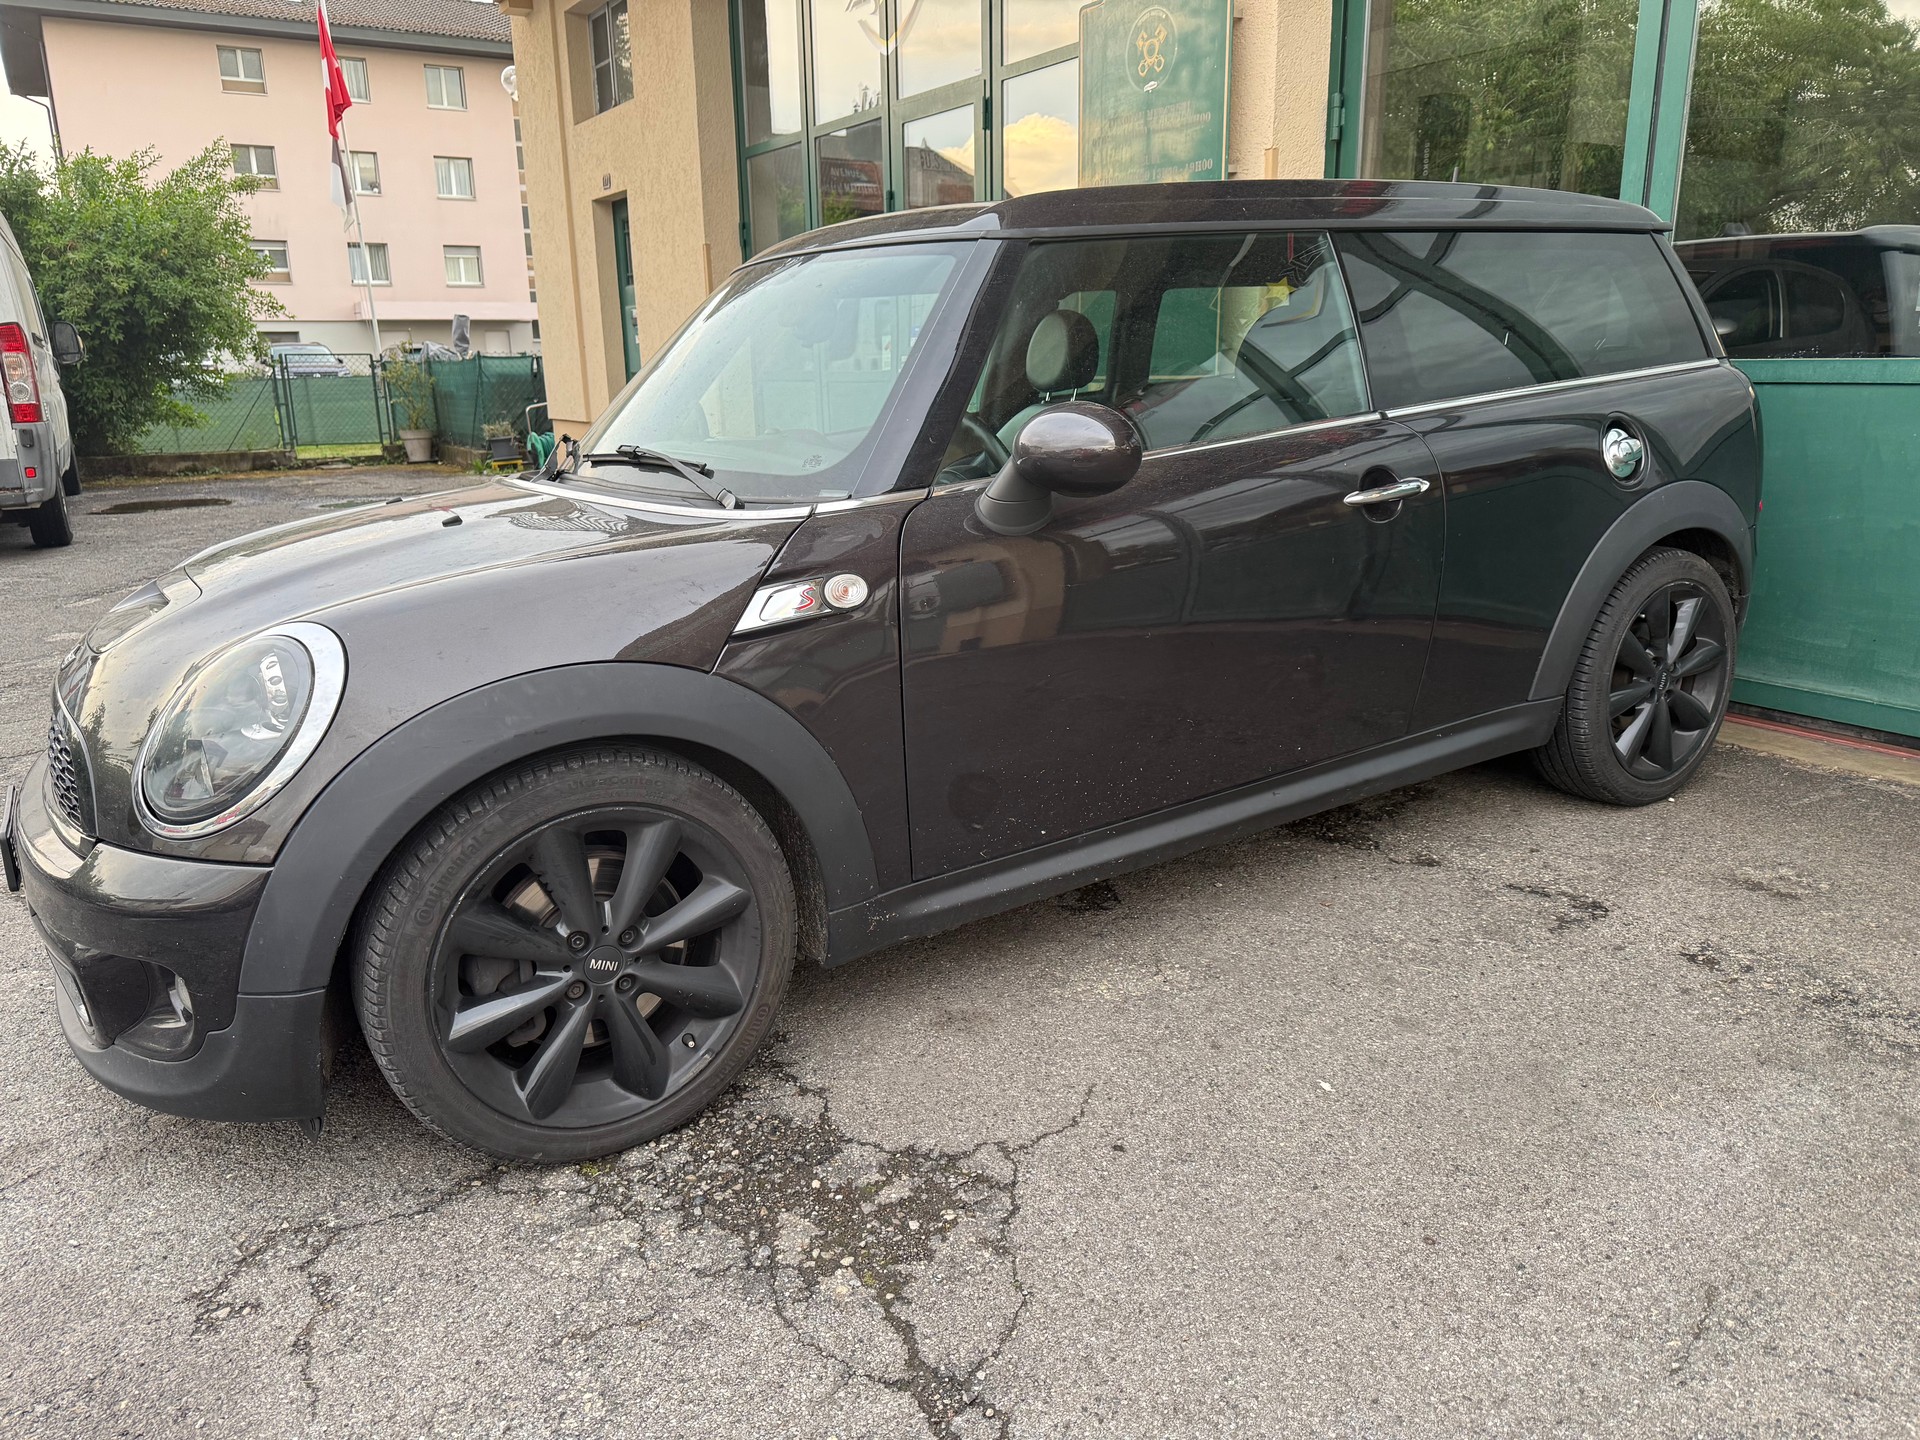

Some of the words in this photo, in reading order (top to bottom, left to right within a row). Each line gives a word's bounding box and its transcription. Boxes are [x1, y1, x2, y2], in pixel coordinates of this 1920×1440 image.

[795, 586, 815, 610] S
[1658, 672, 1667, 690] MINI
[589, 958, 618, 972] MINI
